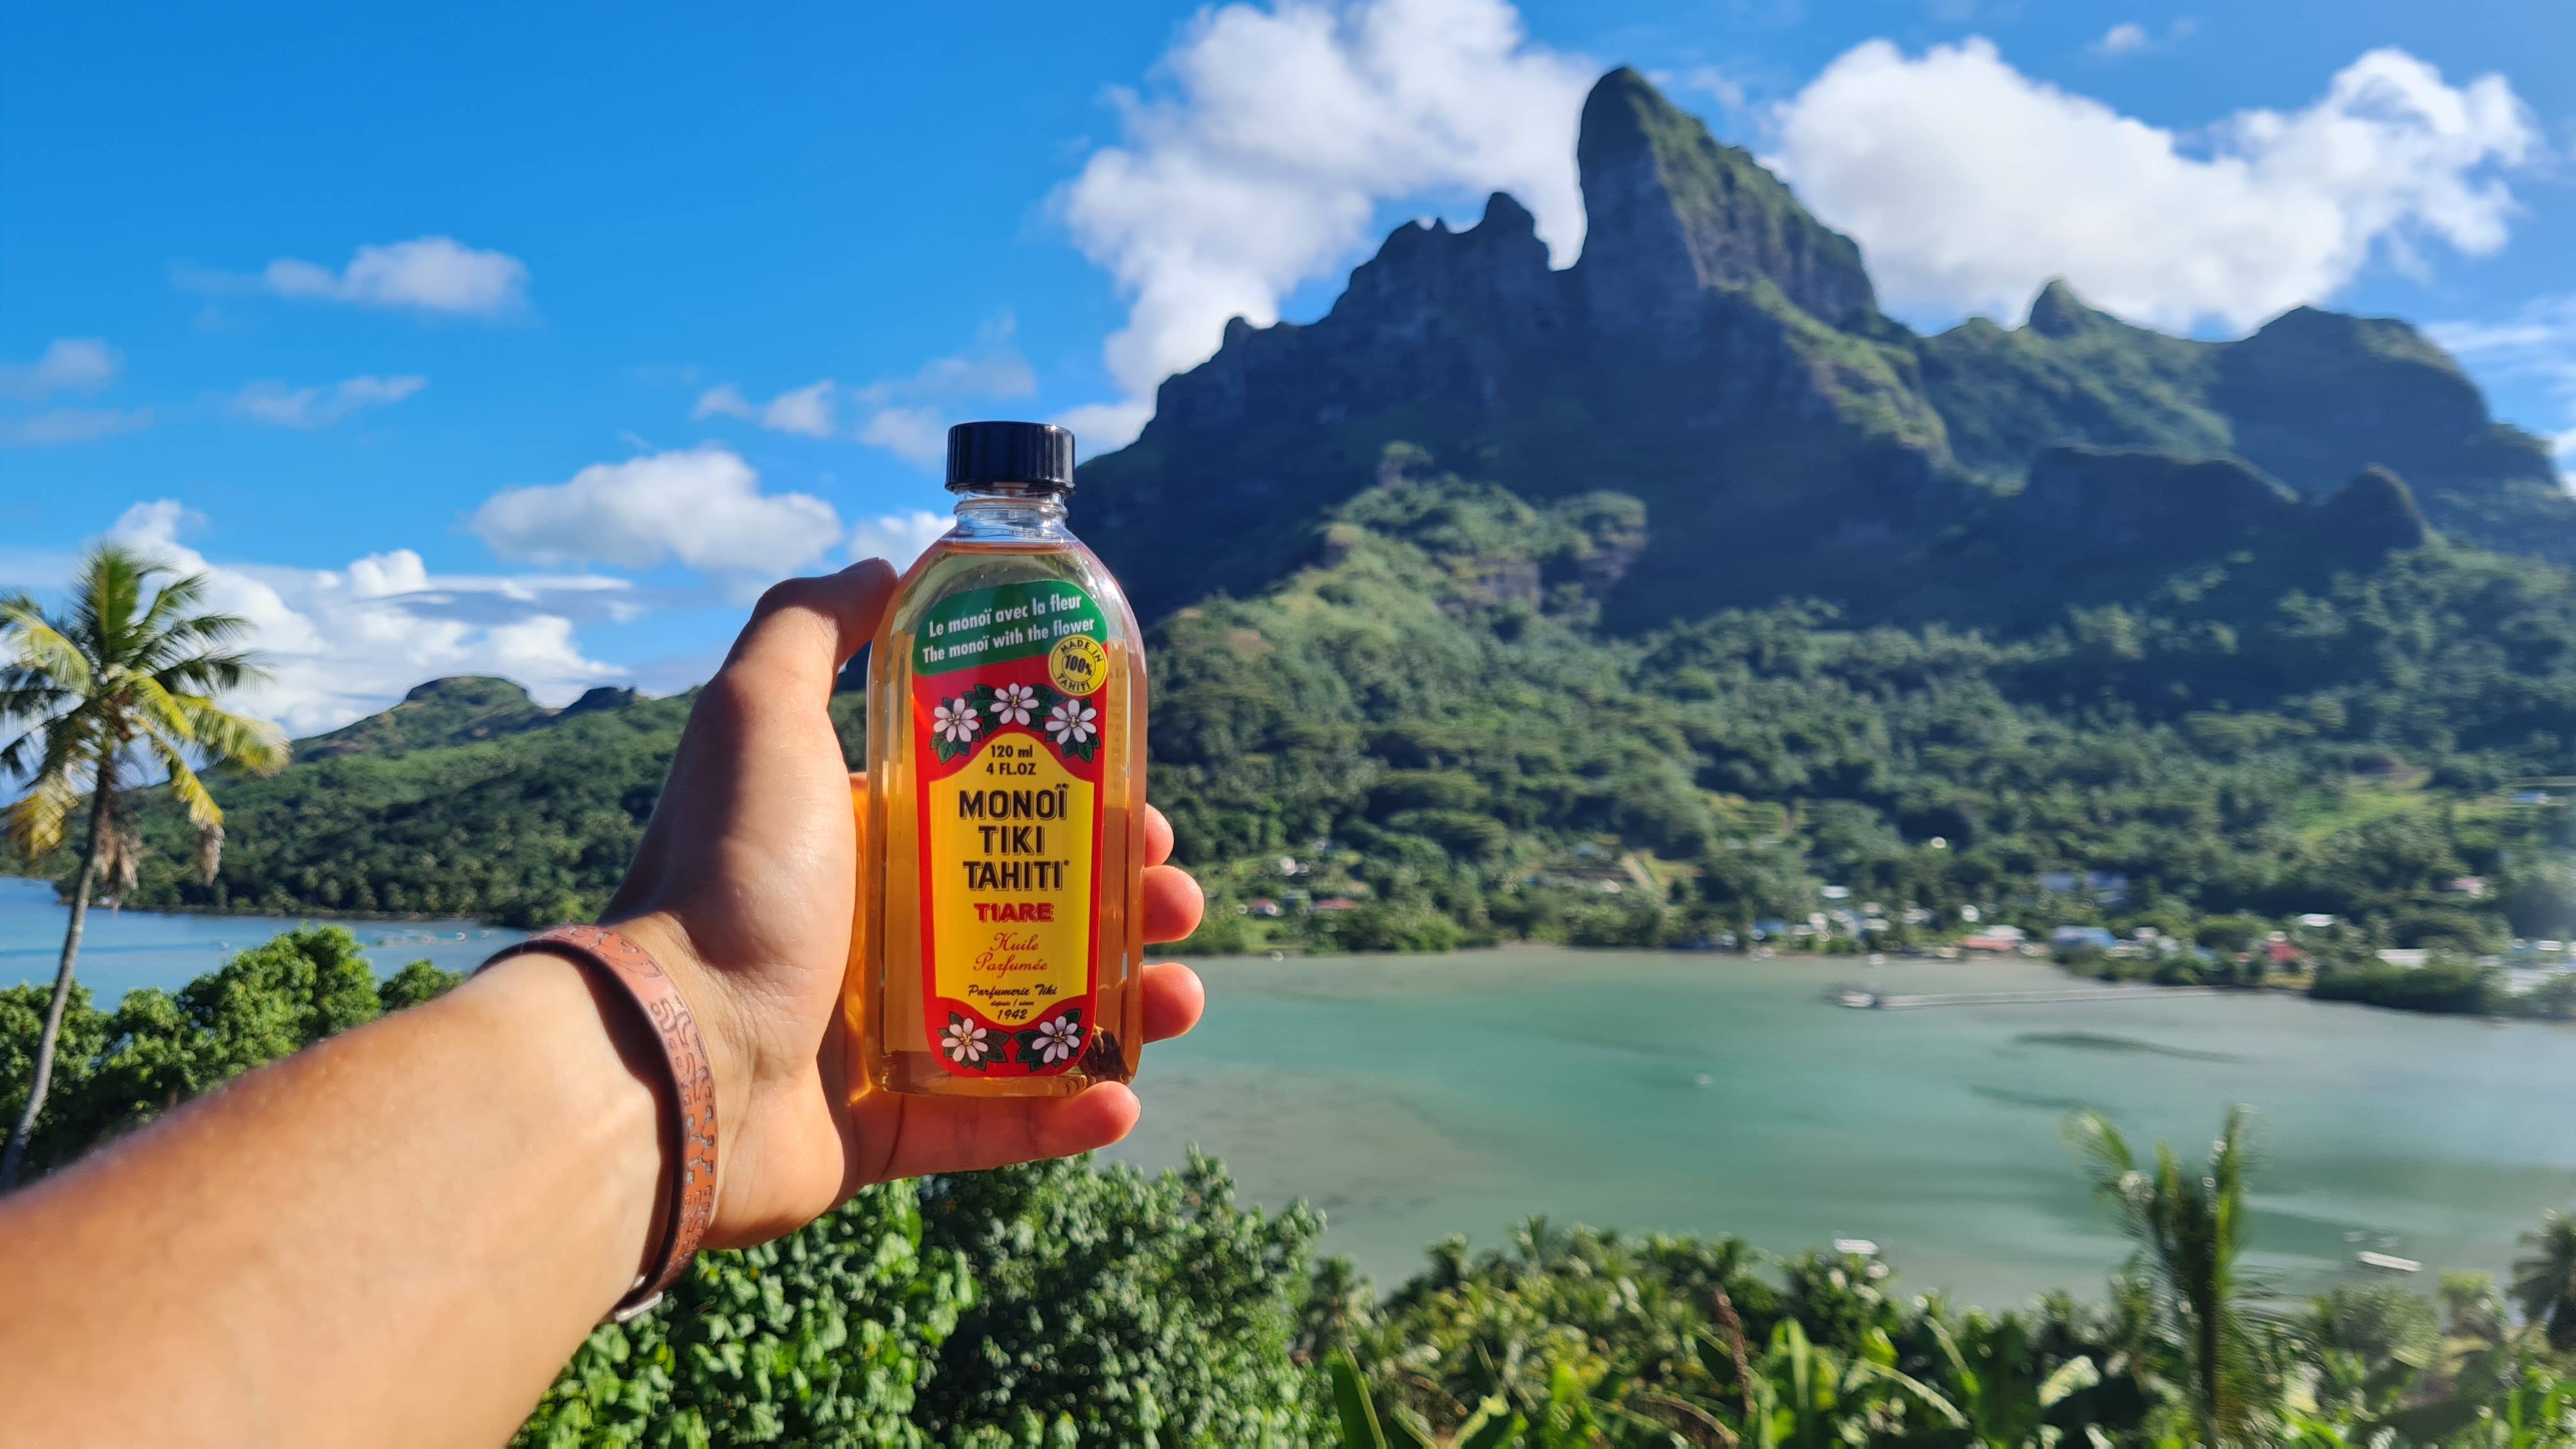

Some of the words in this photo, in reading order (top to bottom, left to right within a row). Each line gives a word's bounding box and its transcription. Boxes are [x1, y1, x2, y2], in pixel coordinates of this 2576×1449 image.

[930, 621, 944, 638] Le
[949, 608, 992, 633] monoï
[995, 606, 1029, 624] avec
[1032, 598, 1046, 616] la
[1050, 594, 1082, 613] fleur
[923, 647, 944, 664] The
[949, 635, 990, 657] monoï
[993, 631, 1023, 649] with
[1027, 627, 1049, 642] the
[1054, 618, 1095, 637] flower
[1061, 640, 1091, 654] MADE
[1092, 649, 1104, 663] IN
[1065, 655, 1092, 676] 100%
[1057, 673, 1091, 691] TAHITI
[991, 745, 1014, 758] 120
[1018, 745, 1033, 758] ml
[986, 763, 994, 775] 4
[999, 763, 1037, 776] FL.OZ
[959, 783, 1070, 821] MONOÏ
[978, 825, 1045, 855] TIKI
[973, 903, 1055, 923] TIARE
[990, 932, 1039, 951] Huile
[973, 952, 1048, 978] Parfumée
[968, 984, 1031, 999] Parfumerie
[1034, 984, 1058, 997] Tiki
[997, 1009, 1029, 1020] 1942
